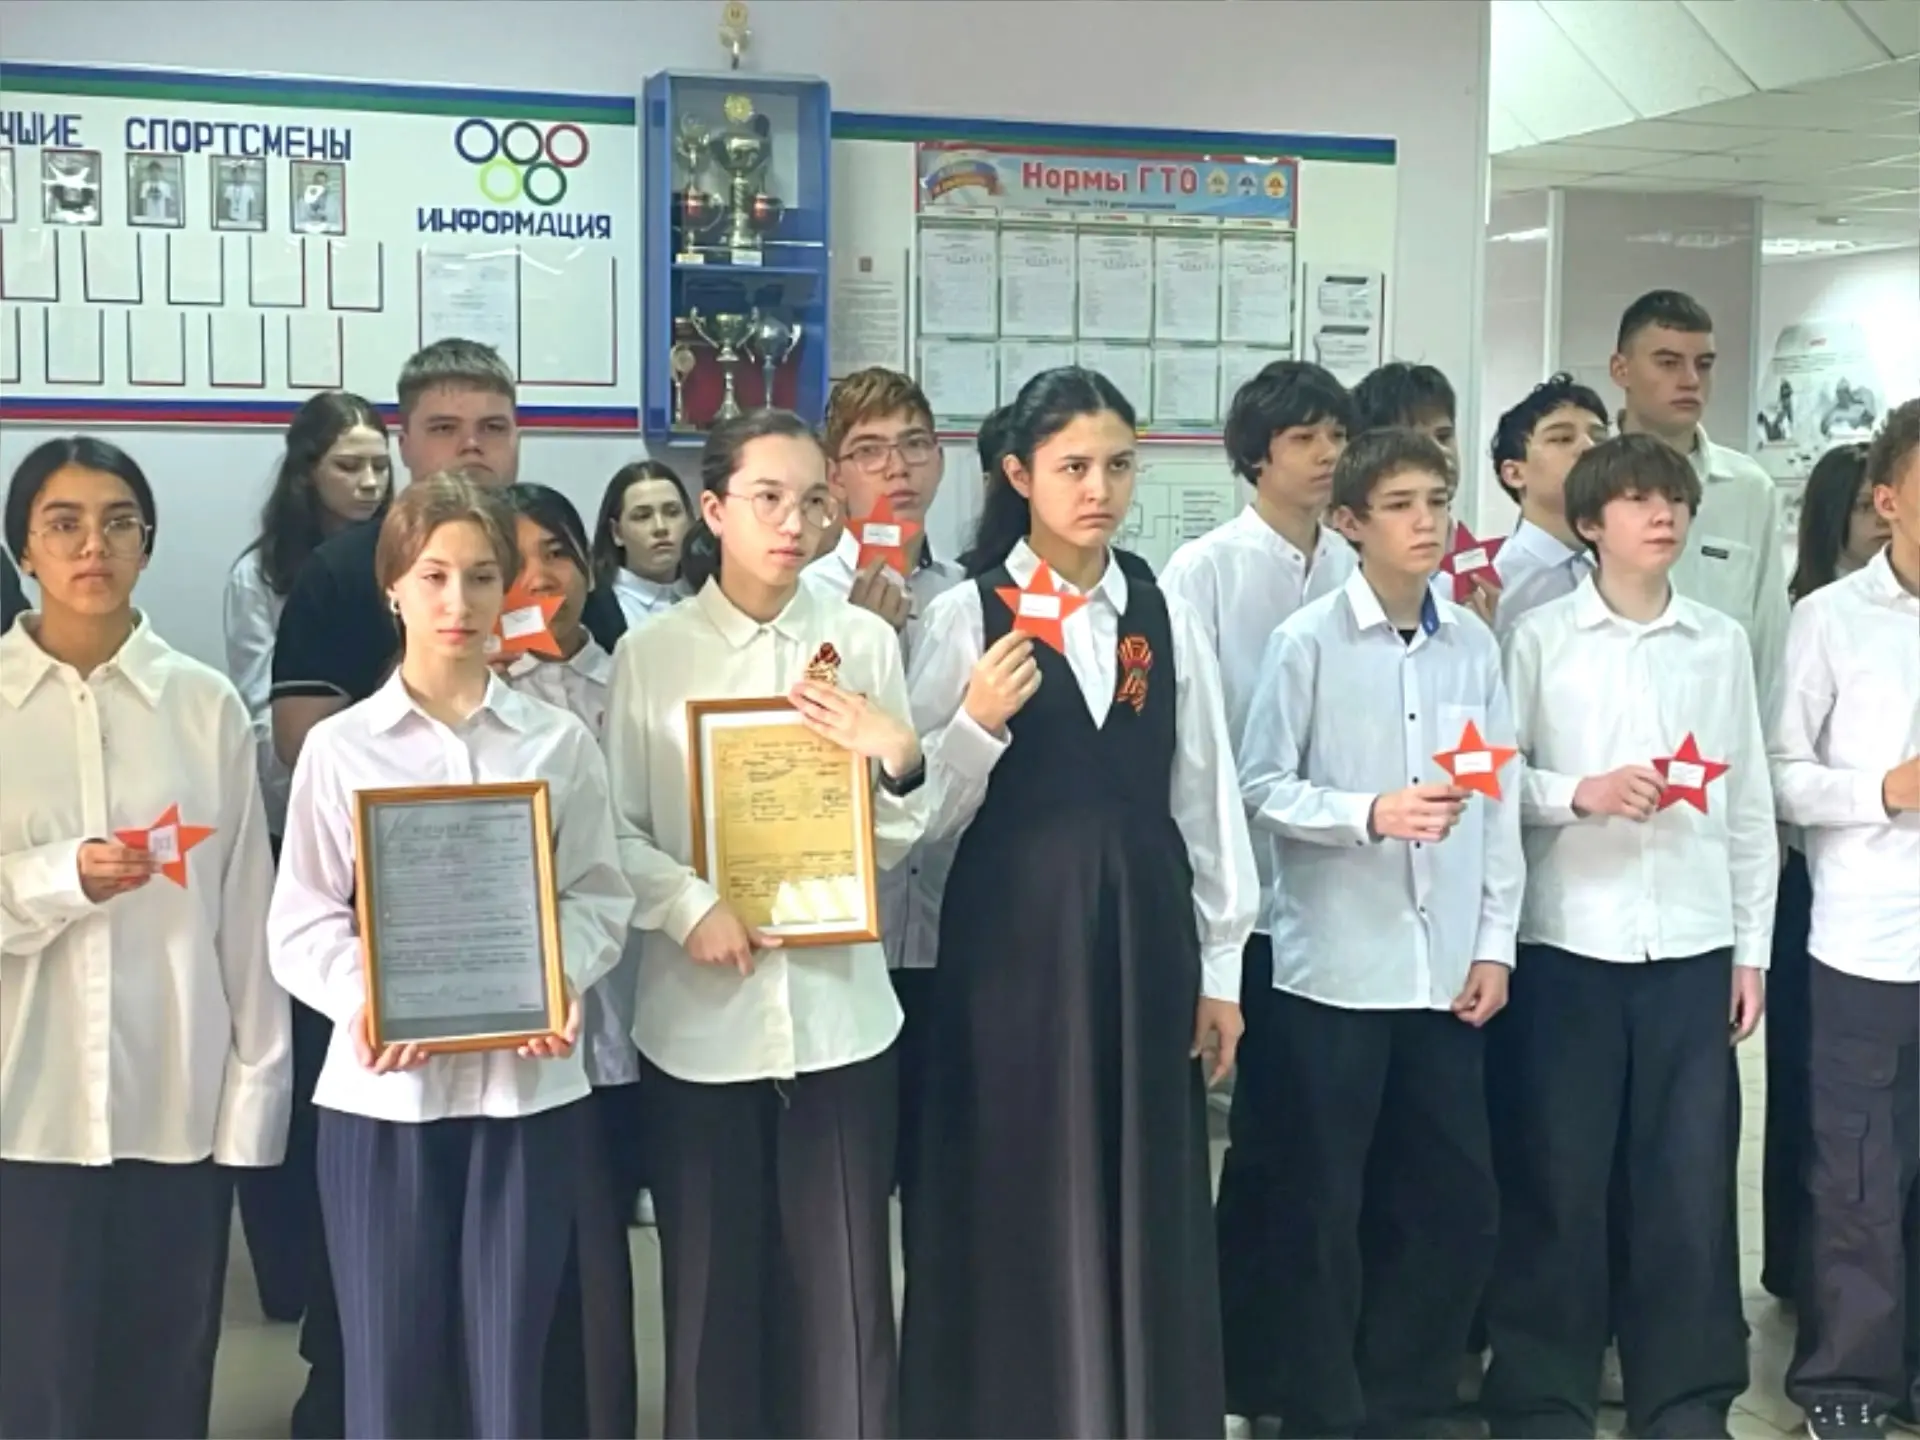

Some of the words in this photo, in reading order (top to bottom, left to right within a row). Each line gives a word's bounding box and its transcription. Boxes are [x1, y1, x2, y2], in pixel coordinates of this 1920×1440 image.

[0, 111, 83, 147] ЧШИЕ
[125, 118, 351, 160] СПОРТСМЕНЫ
[1022, 161, 1127, 196] Нормы
[1139, 166, 1198, 194] ГТО
[418, 207, 611, 239] ИНФОРМАЦИЯ
